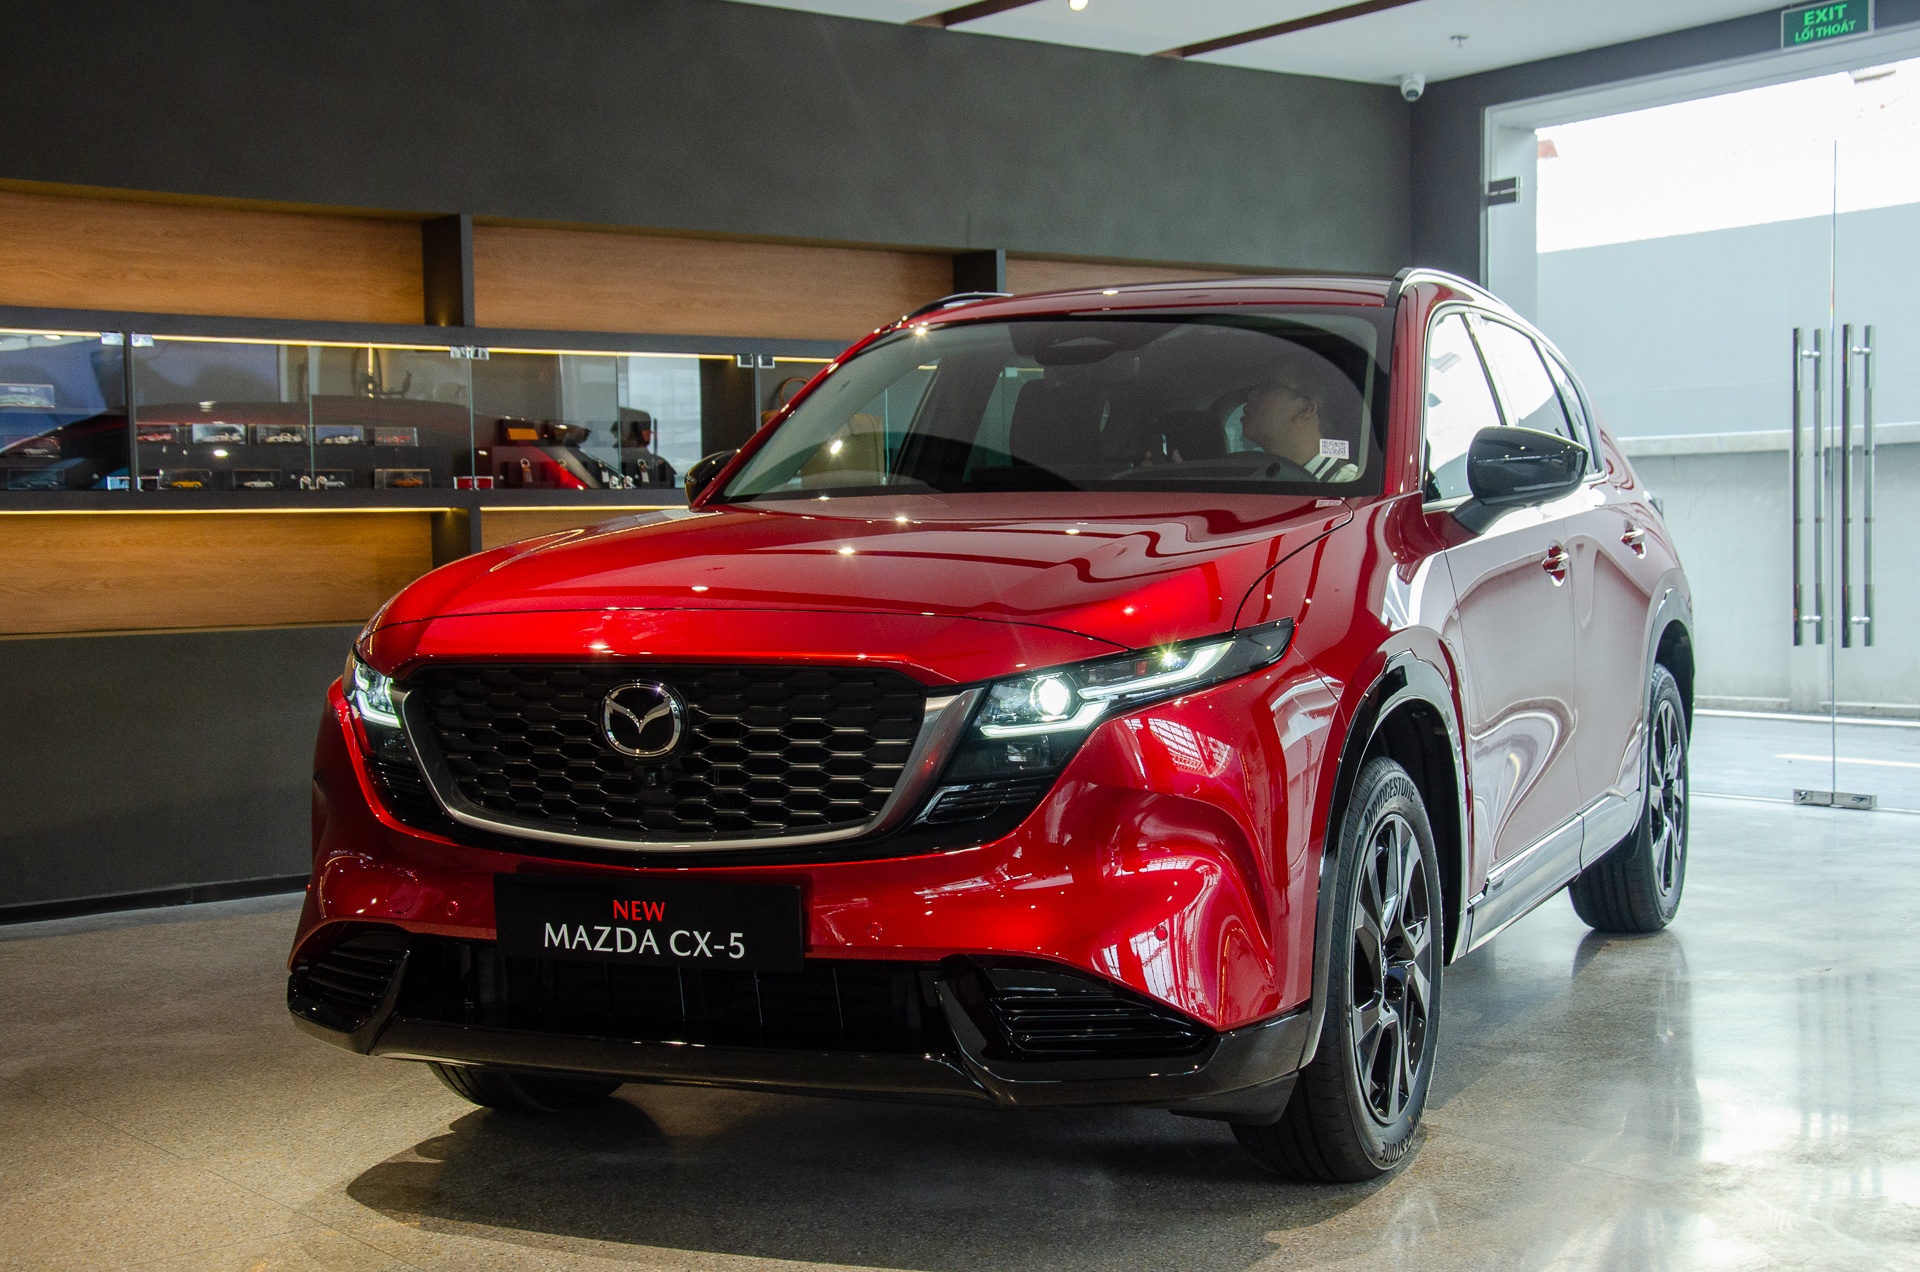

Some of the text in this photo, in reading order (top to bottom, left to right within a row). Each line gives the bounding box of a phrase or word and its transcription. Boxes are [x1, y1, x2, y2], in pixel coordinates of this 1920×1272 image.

[1804, 4, 1847, 25] EXIT
[1794, 19, 1856, 44] LỐI THOÁT
[613, 899, 665, 922] NEW
[544, 922, 745, 959] MAZDA CX-5
